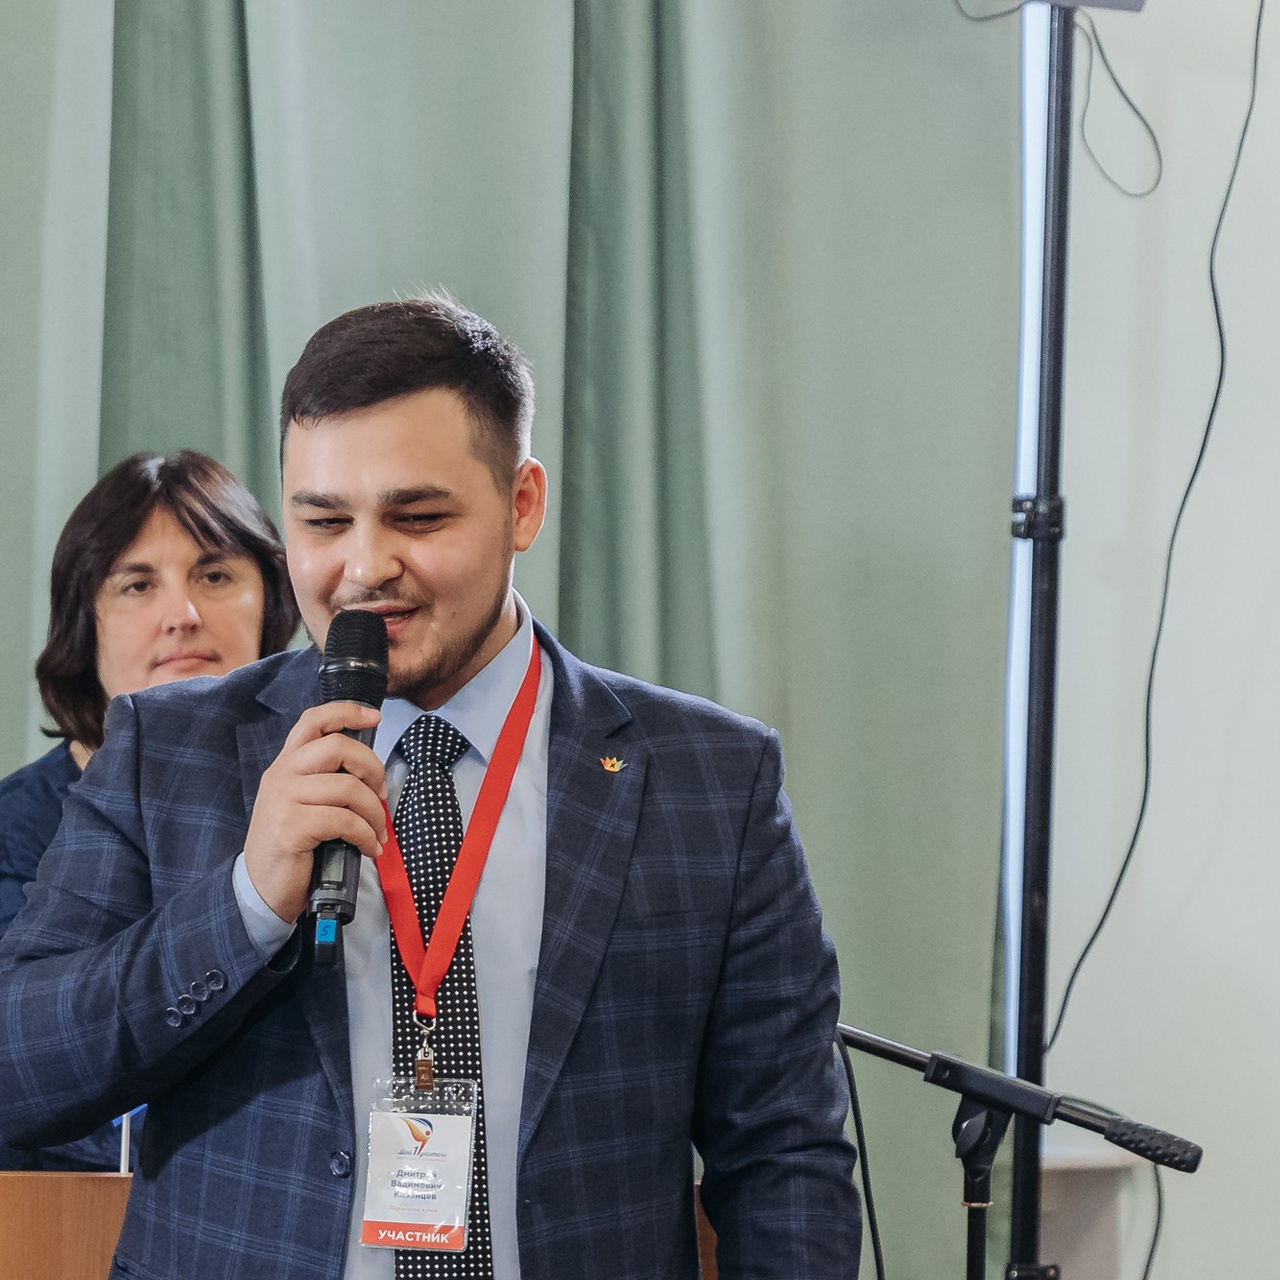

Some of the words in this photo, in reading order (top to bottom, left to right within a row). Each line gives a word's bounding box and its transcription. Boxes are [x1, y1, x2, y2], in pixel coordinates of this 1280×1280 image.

[320, 925, 332, 936] 5
[396, 1169, 437, 1179] Дмитрй
[391, 1179, 442, 1189] Вадимович
[378, 1229, 449, 1244] УЧАСТНИК
